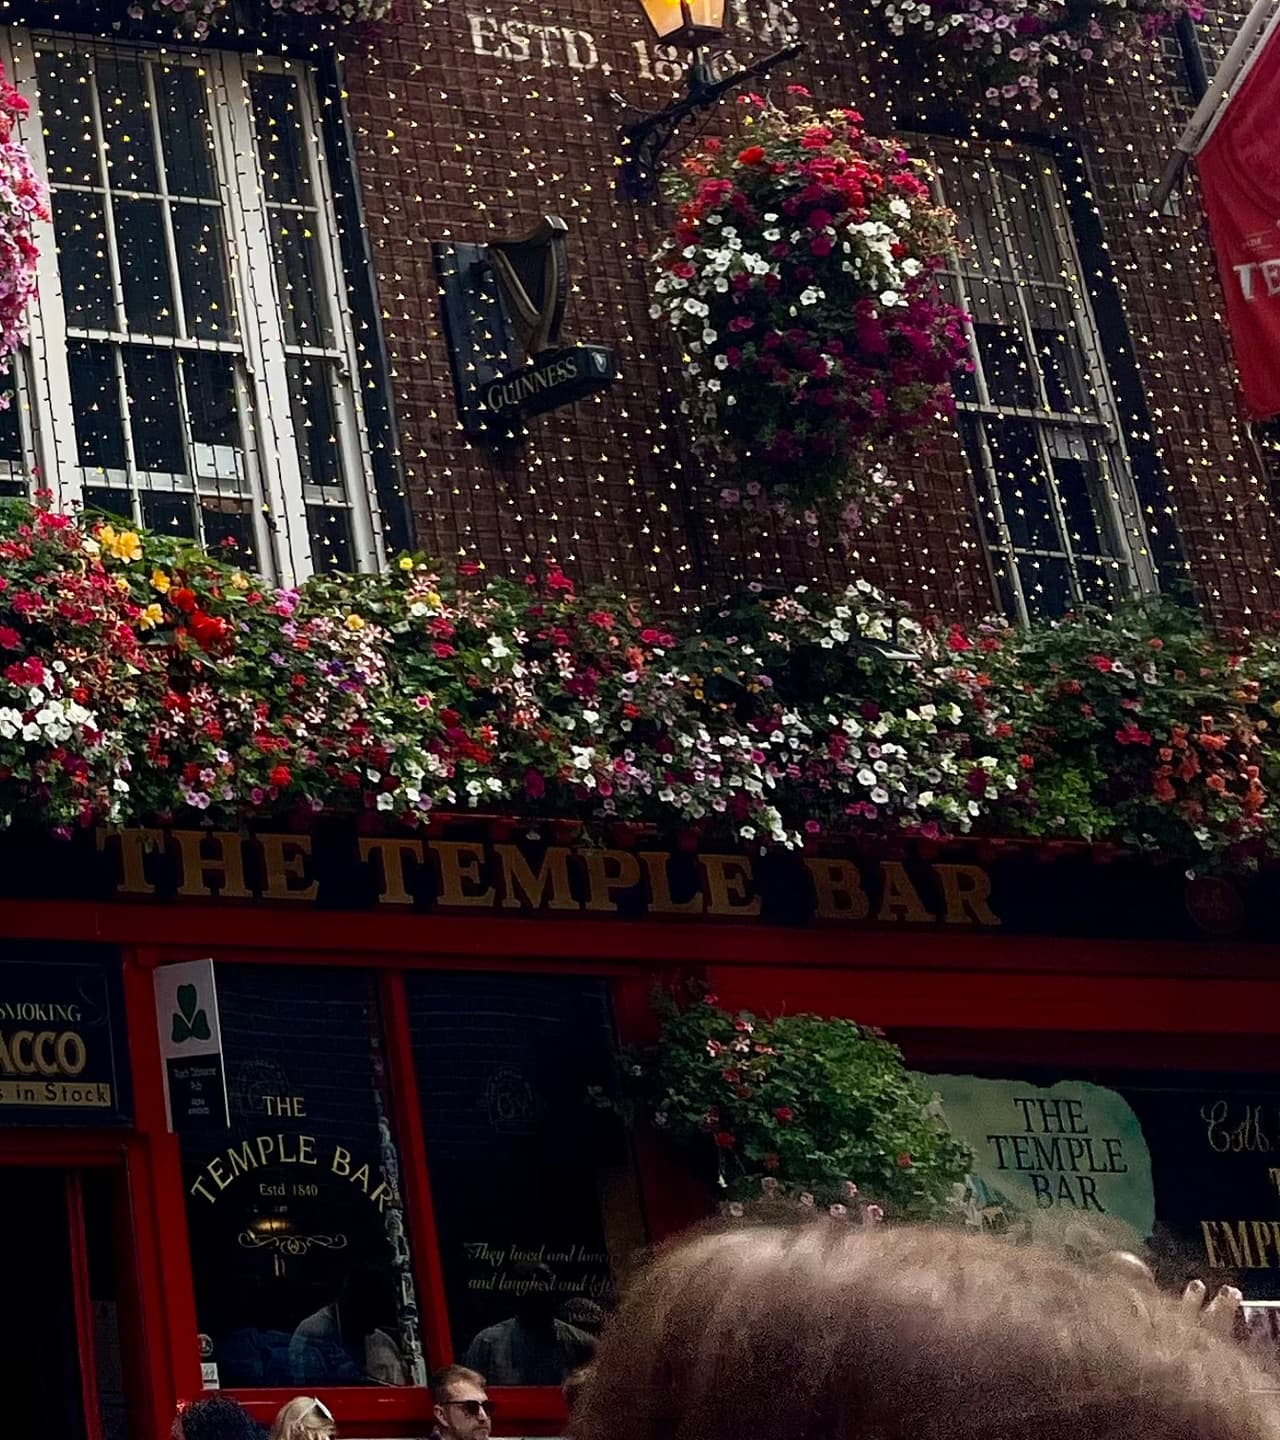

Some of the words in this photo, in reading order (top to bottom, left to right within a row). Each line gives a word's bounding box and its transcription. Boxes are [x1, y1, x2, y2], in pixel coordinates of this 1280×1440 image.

[487, 356, 578, 413] GUINNESS
[95, 825, 320, 903] THE
[357, 835, 762, 917] TEMPLE
[801, 855, 1004, 927] BAR
[16, 1082, 35, 1101] in
[44, 1083, 109, 1103] Stock
[261, 1095, 307, 1118] THE
[1013, 1097, 1089, 1135] THE
[190, 1133, 318, 1205] TEMPLE
[330, 1144, 395, 1214] BAR
[986, 1134, 1128, 1174] TEMPLE
[292, 1183, 319, 1197] 1840
[1030, 1173, 1106, 1213] BAR
